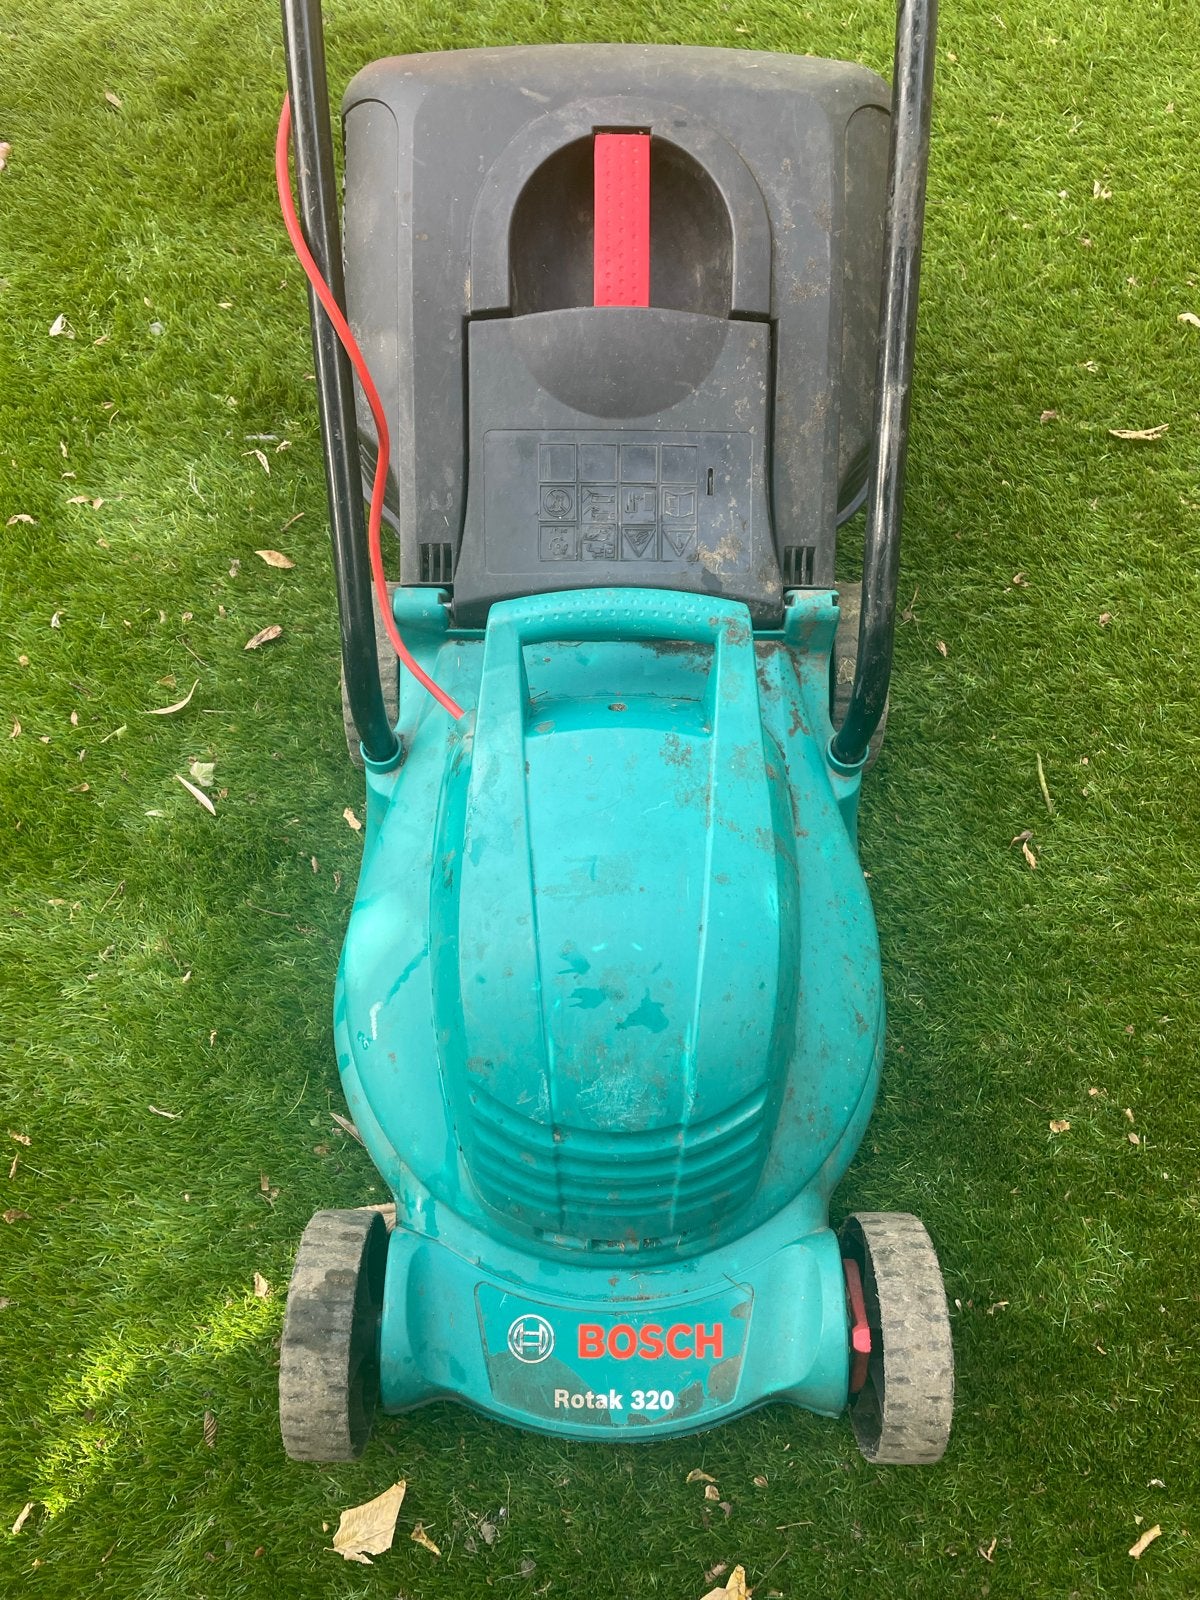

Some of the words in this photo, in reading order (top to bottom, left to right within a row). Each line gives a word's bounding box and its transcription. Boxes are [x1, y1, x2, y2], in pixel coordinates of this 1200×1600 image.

[577, 1323, 724, 1360] BOSCH
[554, 1389, 623, 1410] Rotak
[631, 1390, 675, 1410] 320
